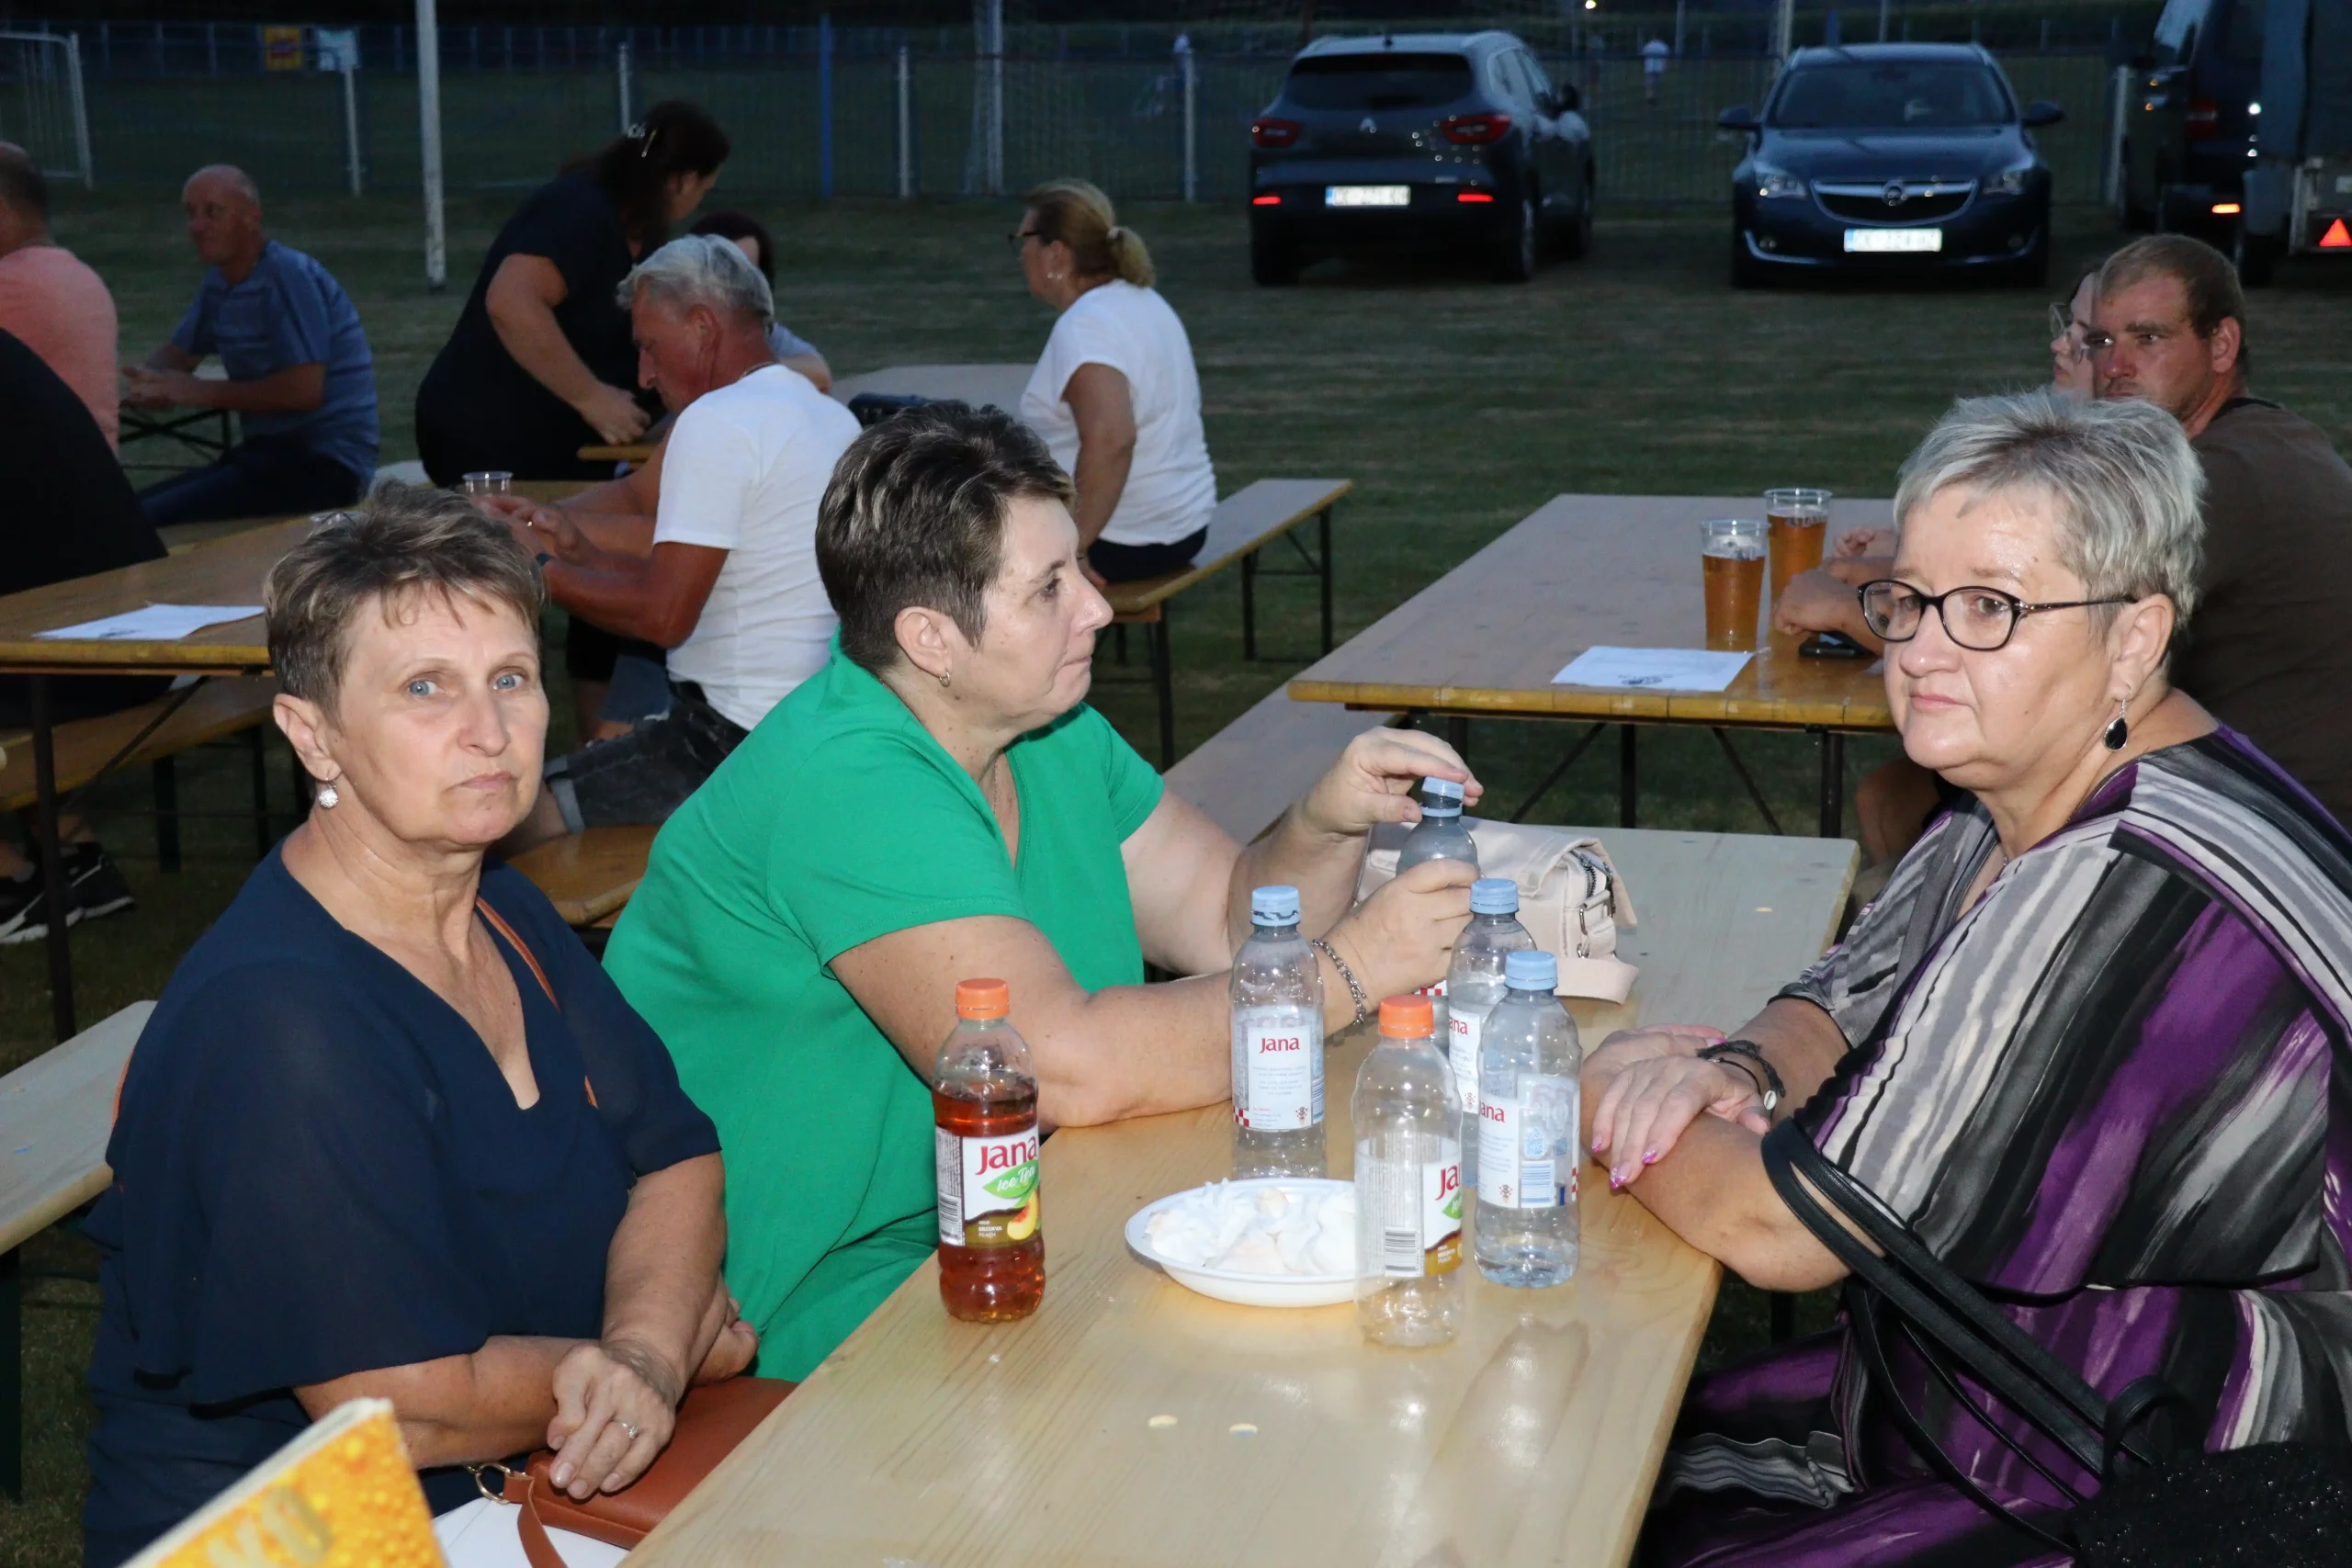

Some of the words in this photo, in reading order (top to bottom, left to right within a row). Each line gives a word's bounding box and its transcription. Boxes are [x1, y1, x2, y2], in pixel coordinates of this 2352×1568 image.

[1448, 1016, 1468, 1035] ana
[1259, 1037, 1301, 1054] Jana
[975, 1135, 1037, 1175] Jana
